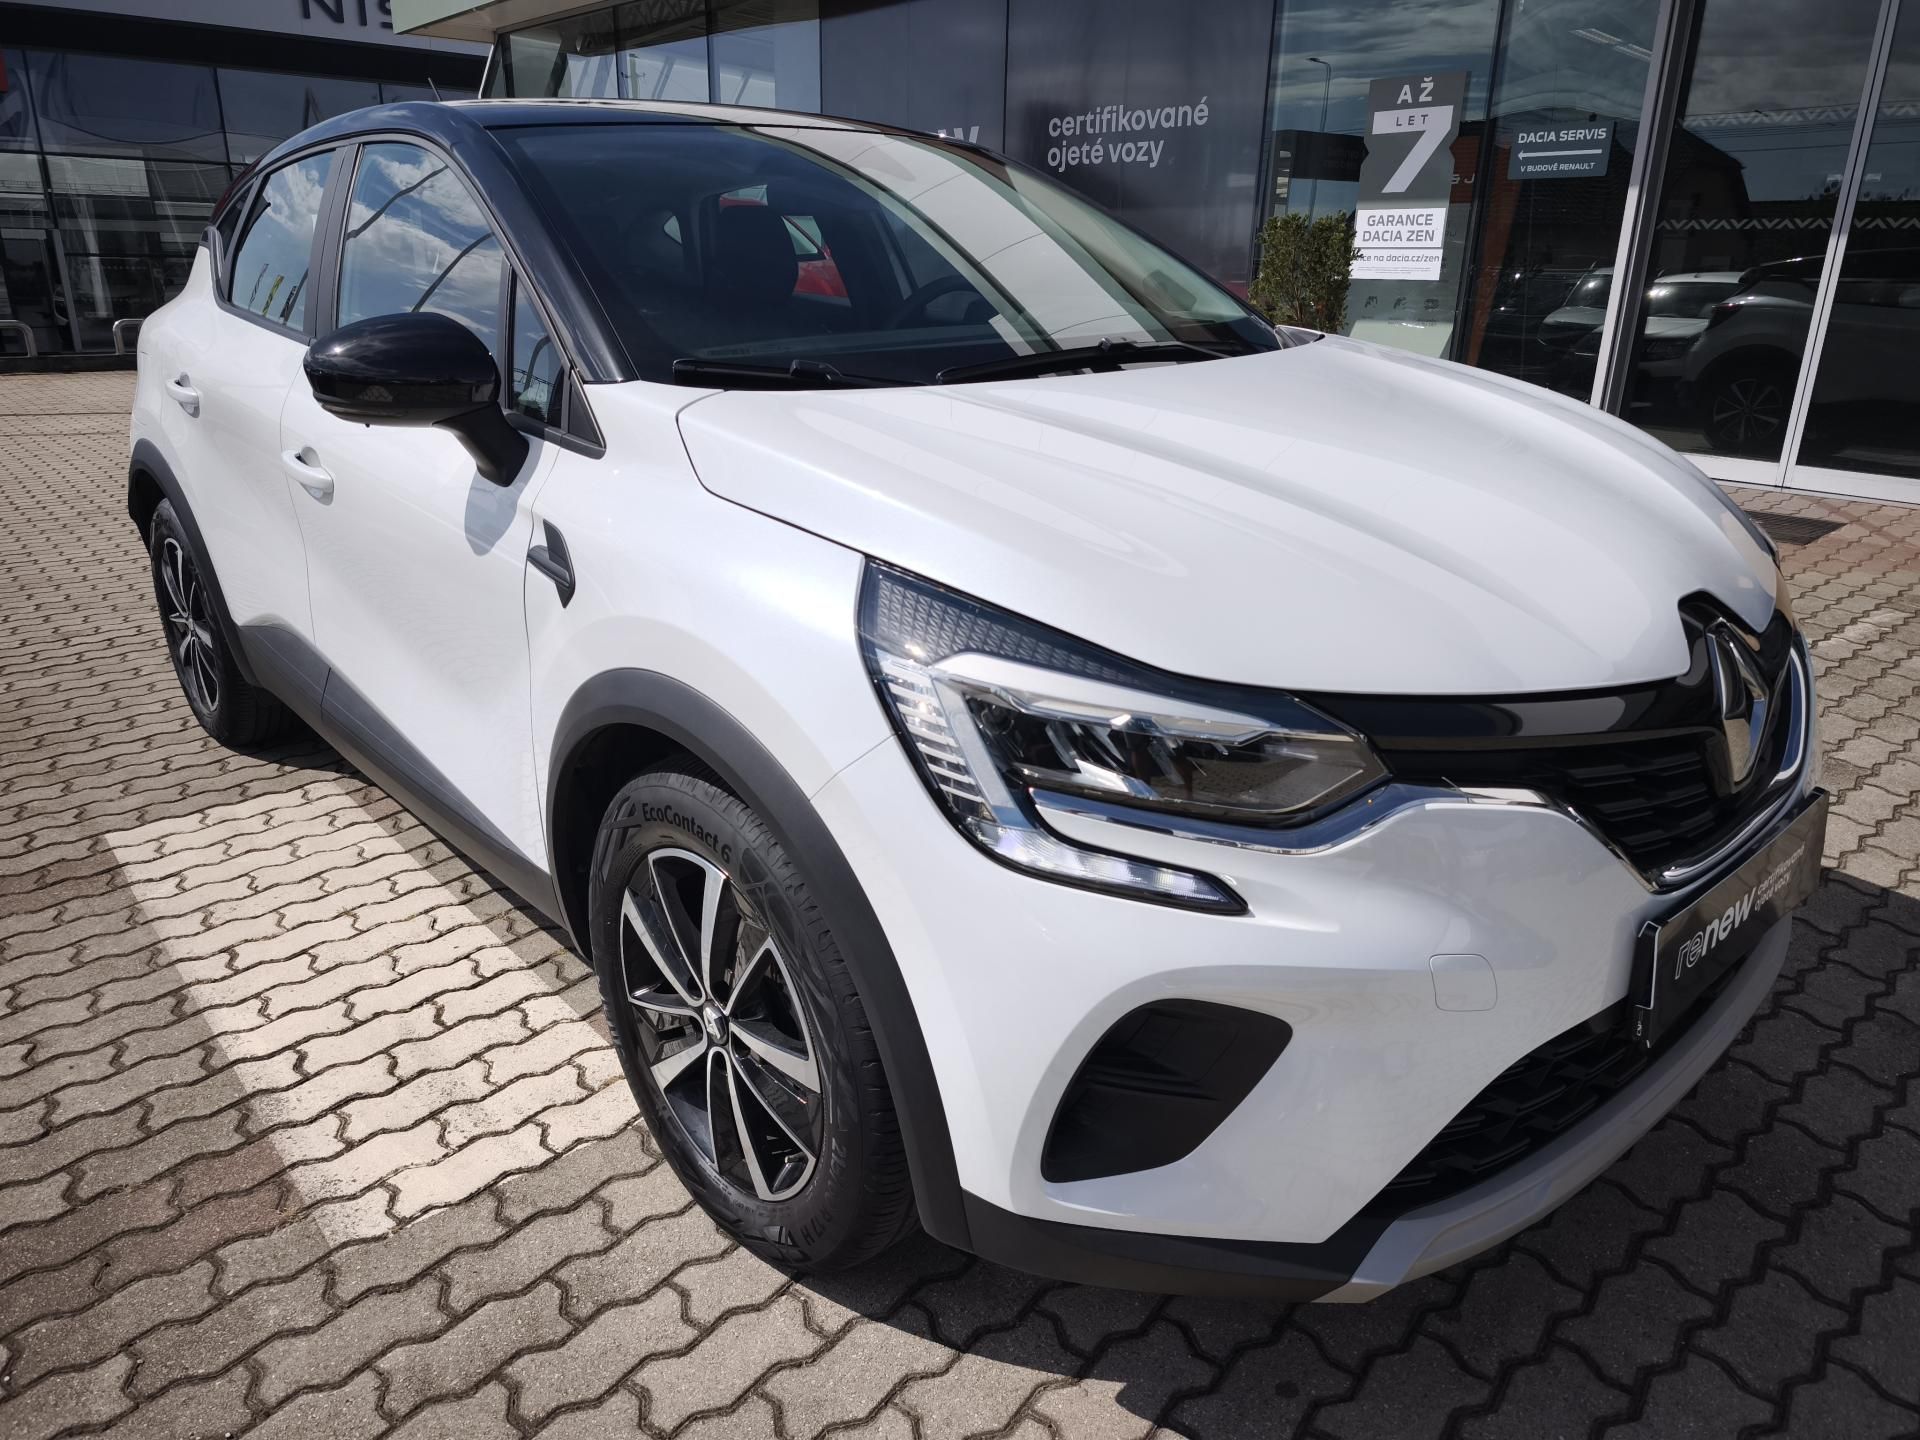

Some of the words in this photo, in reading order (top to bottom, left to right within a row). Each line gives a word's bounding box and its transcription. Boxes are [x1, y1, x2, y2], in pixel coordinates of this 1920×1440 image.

[1396, 76, 1434, 105] AŽ
[1048, 96, 1209, 138] certifikované
[1395, 113, 1429, 127] LET
[1518, 131, 1556, 144] DACIA
[1559, 128, 1607, 141] SERVIS
[1047, 138, 1104, 173] ojeté
[1108, 140, 1165, 168] vozy
[1371, 104, 1454, 193] 7
[1520, 165, 1526, 173] V
[1559, 162, 1596, 171] RENAULT
[1367, 213, 1434, 227] GARANCE
[1362, 230, 1403, 242] DACIA
[1405, 229, 1435, 242] ZEN
[1385, 253, 1440, 263] dacia.cz/zen
[642, 802, 719, 855] EcoContact
[721, 843, 733, 865] 6
[1674, 886, 1757, 980] renew
